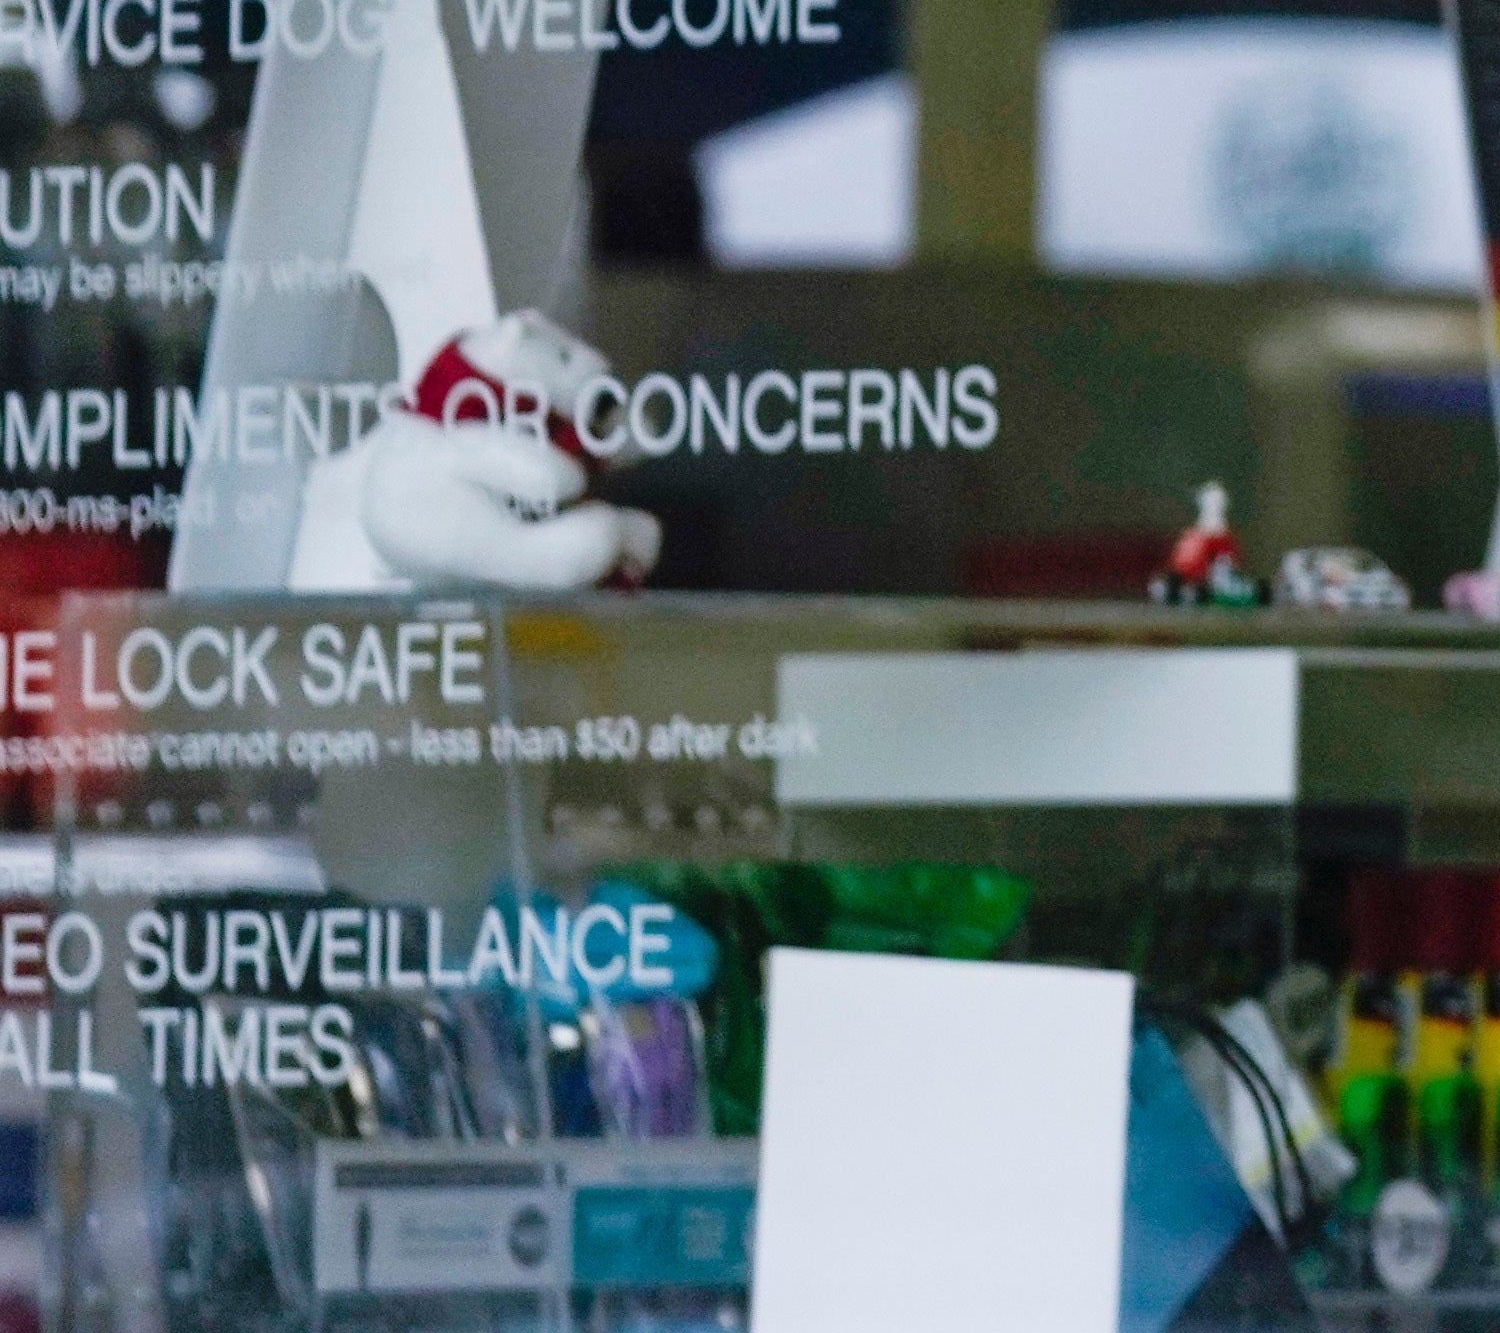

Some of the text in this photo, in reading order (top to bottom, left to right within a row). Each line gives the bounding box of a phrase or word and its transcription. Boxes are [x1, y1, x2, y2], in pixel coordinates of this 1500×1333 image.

[0, 161, 217, 249] UTION
[70, 254, 115, 300] be
[443, 375, 550, 447] OR
[573, 364, 1000, 458] CONCERNS
[0, 621, 486, 712] E LOCK SAFE
[159, 727, 282, 770] cannot
[287, 728, 379, 776] open
[409, 717, 482, 766] less
[489, 714, 568, 763] than
[648, 713, 731, 763] after
[124, 903, 675, 995] SURVEILLANCE
[0, 1002, 355, 1094] ALL TIMES
